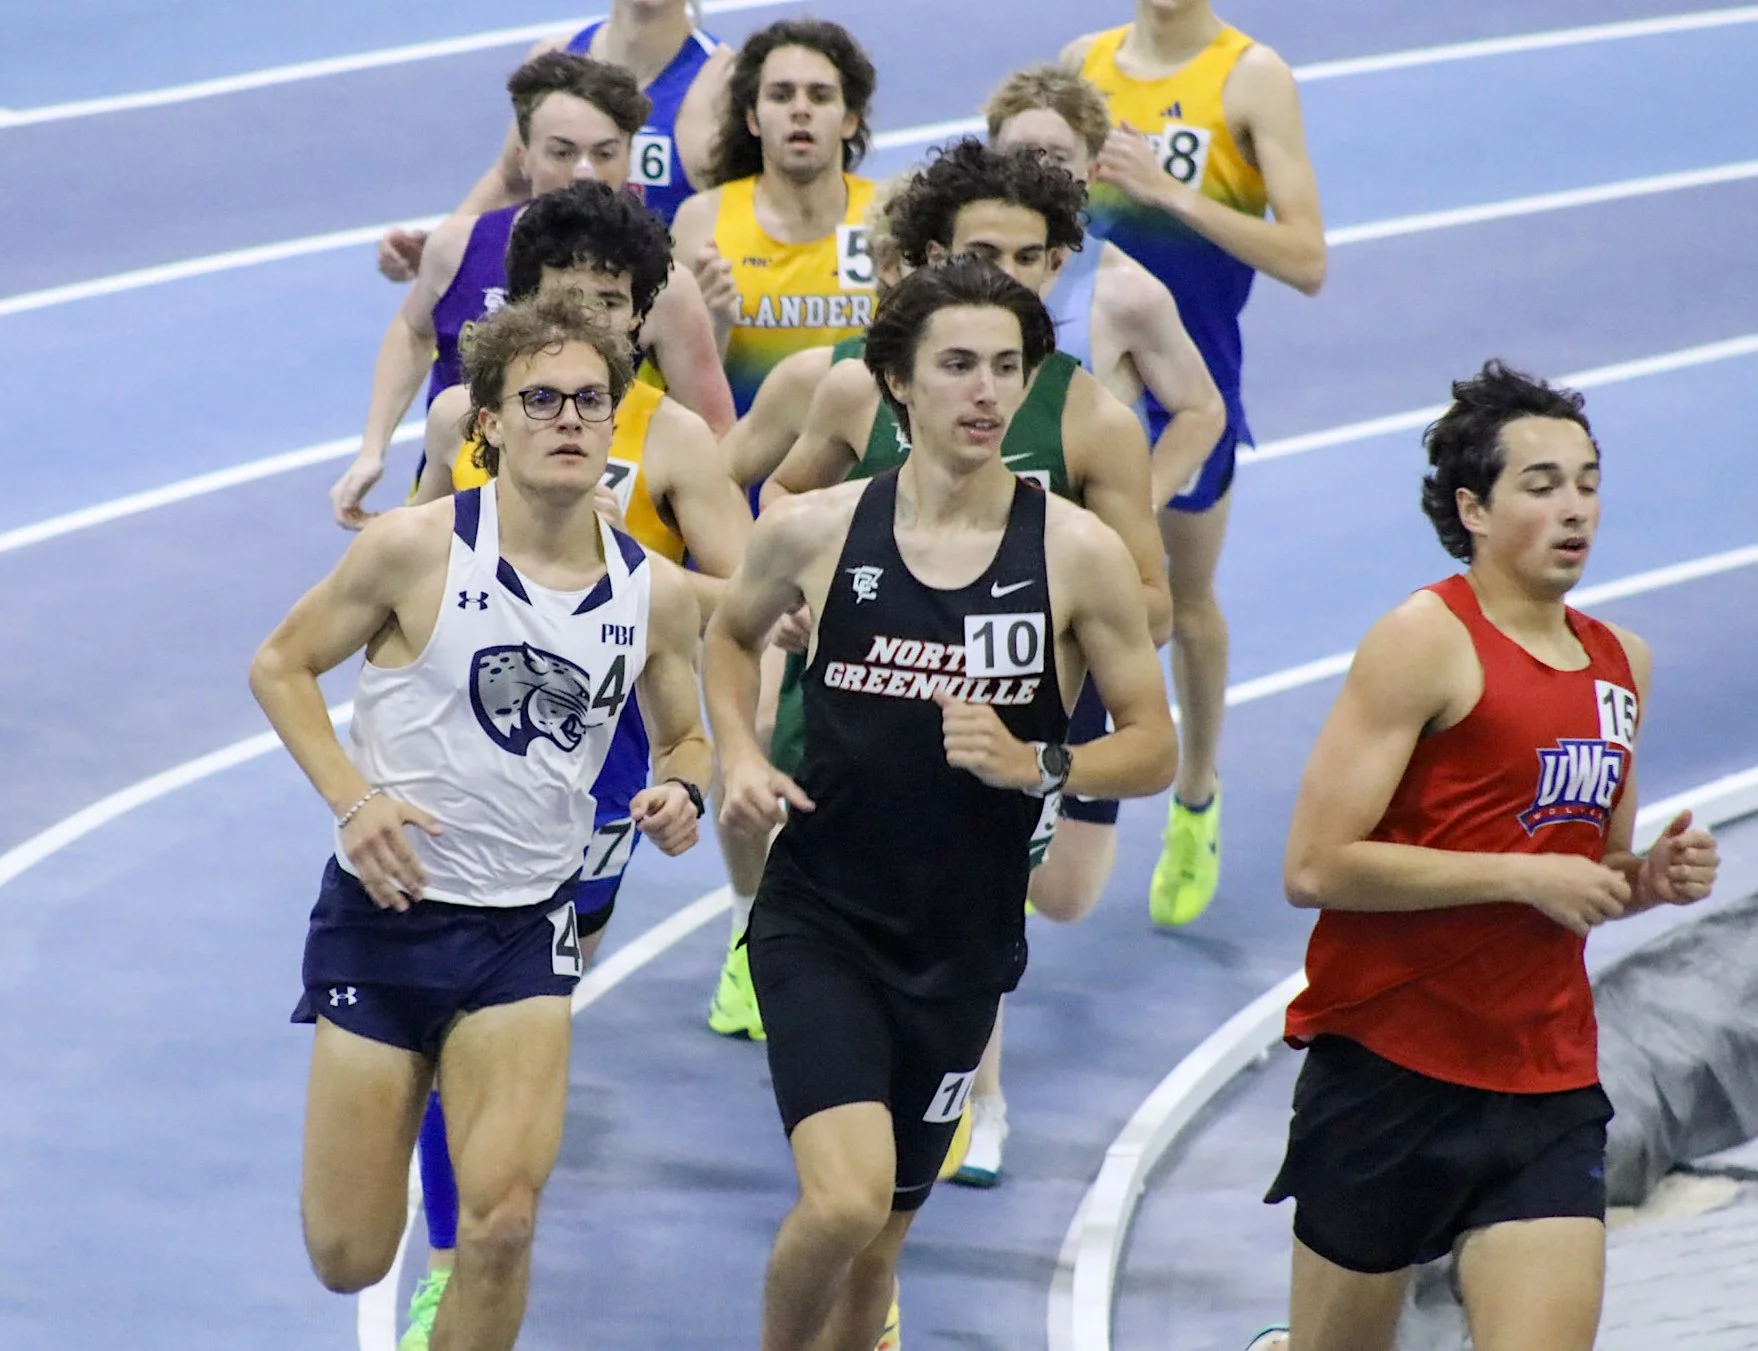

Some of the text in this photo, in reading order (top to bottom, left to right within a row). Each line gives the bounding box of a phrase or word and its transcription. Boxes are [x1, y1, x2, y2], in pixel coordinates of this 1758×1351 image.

[641, 143, 664, 180] 6
[1163, 130, 1200, 185] 8
[846, 230, 873, 283] 5
[734, 294, 874, 328] LANDER
[606, 463, 630, 490] 7
[865, 635, 967, 672] NORT
[972, 620, 1039, 669] 10
[592, 654, 626, 717] 4
[823, 661, 1042, 706] GREENVILLE
[1603, 688, 1634, 743] 15
[1537, 745, 1620, 809] UWG
[590, 822, 632, 877] 7
[556, 906, 580, 971] 4
